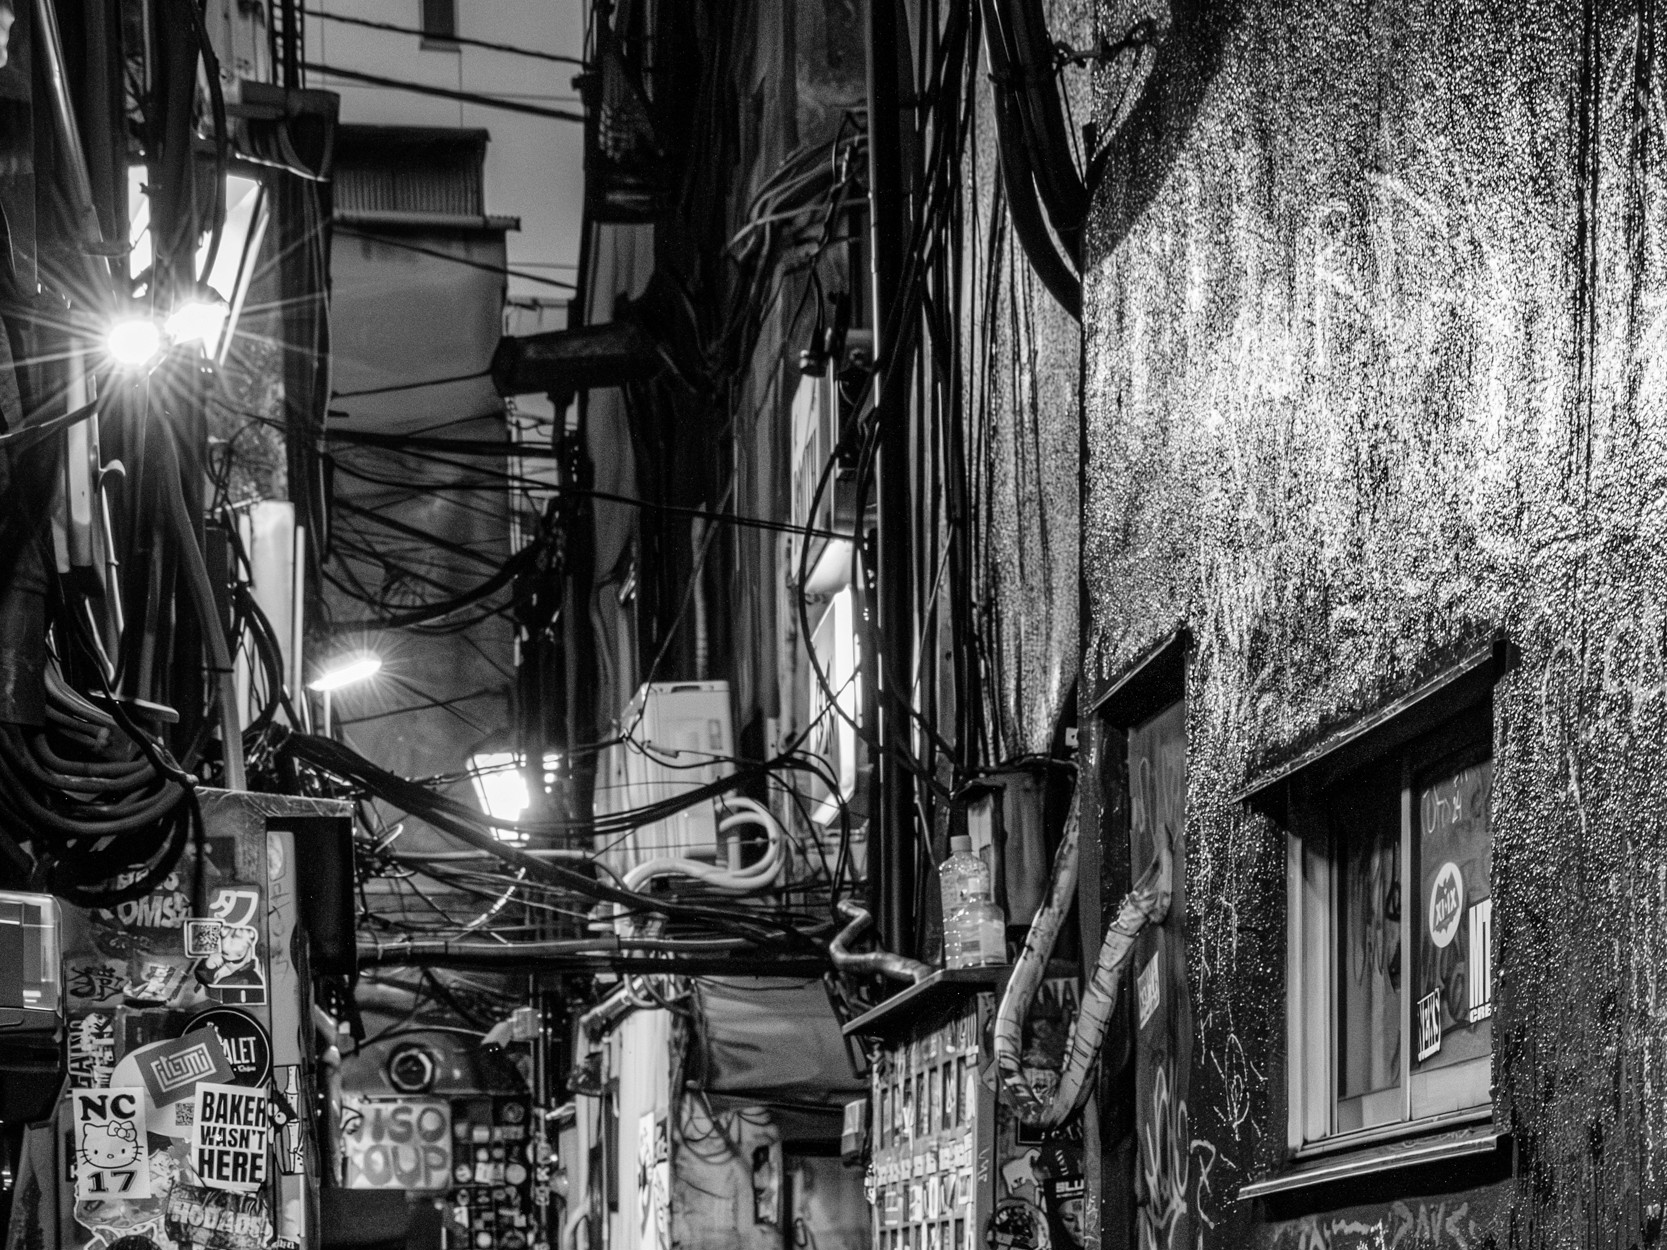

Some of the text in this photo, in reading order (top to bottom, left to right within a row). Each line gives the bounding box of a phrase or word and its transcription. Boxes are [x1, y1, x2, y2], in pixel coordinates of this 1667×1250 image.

[79, 1095, 136, 1121] NC
[201, 1091, 266, 1127] BAKER
[201, 1125, 266, 1150] WASN'T
[198, 1148, 264, 1183] HERE
[87, 1170, 137, 1194] 17
